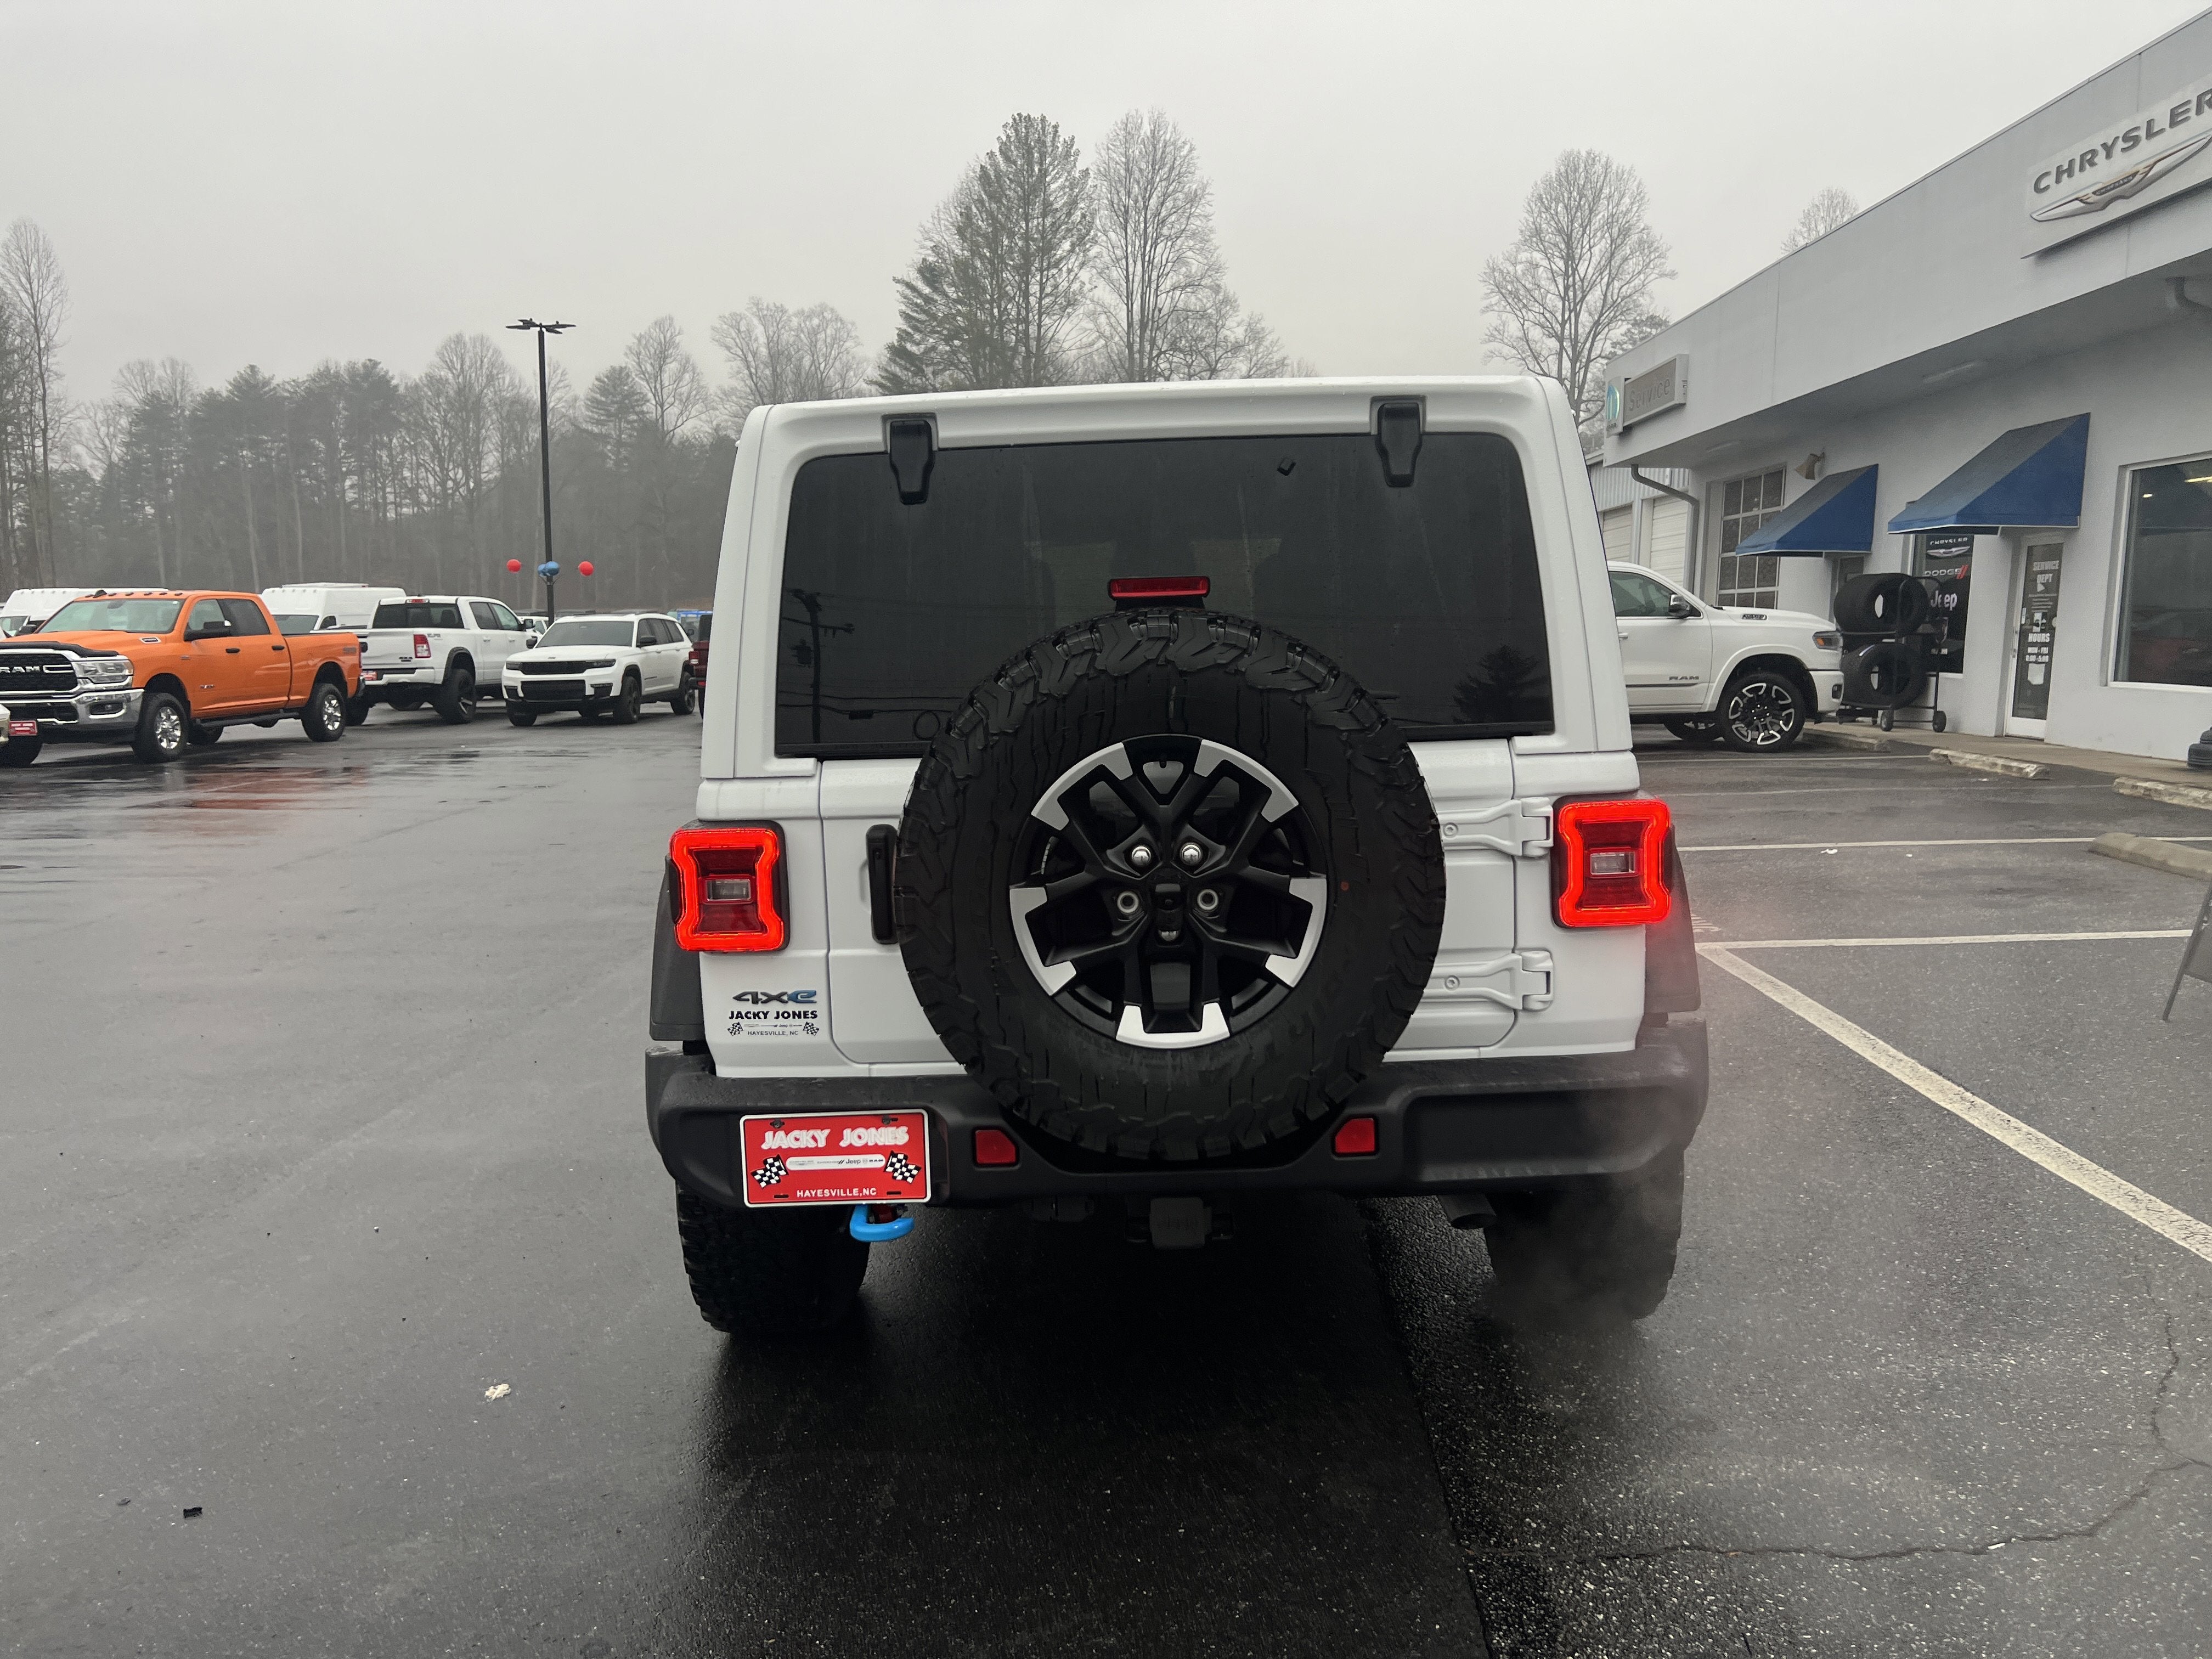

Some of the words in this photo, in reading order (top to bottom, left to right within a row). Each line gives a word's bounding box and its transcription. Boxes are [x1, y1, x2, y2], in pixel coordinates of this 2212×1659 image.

[2033, 88, 2212, 194] CHRYSLER
[1930, 537, 1968, 545] CHRYSLER
[2033, 560, 2059, 571] SERVICE
[1922, 568, 1962, 577] DODGE
[2028, 633, 2050, 642] HOURS
[729, 1011, 770, 1019] JACKY
[774, 1010, 818, 1019] JONES
[761, 1128, 831, 1150] JACKY
[839, 1126, 910, 1147] JONES
